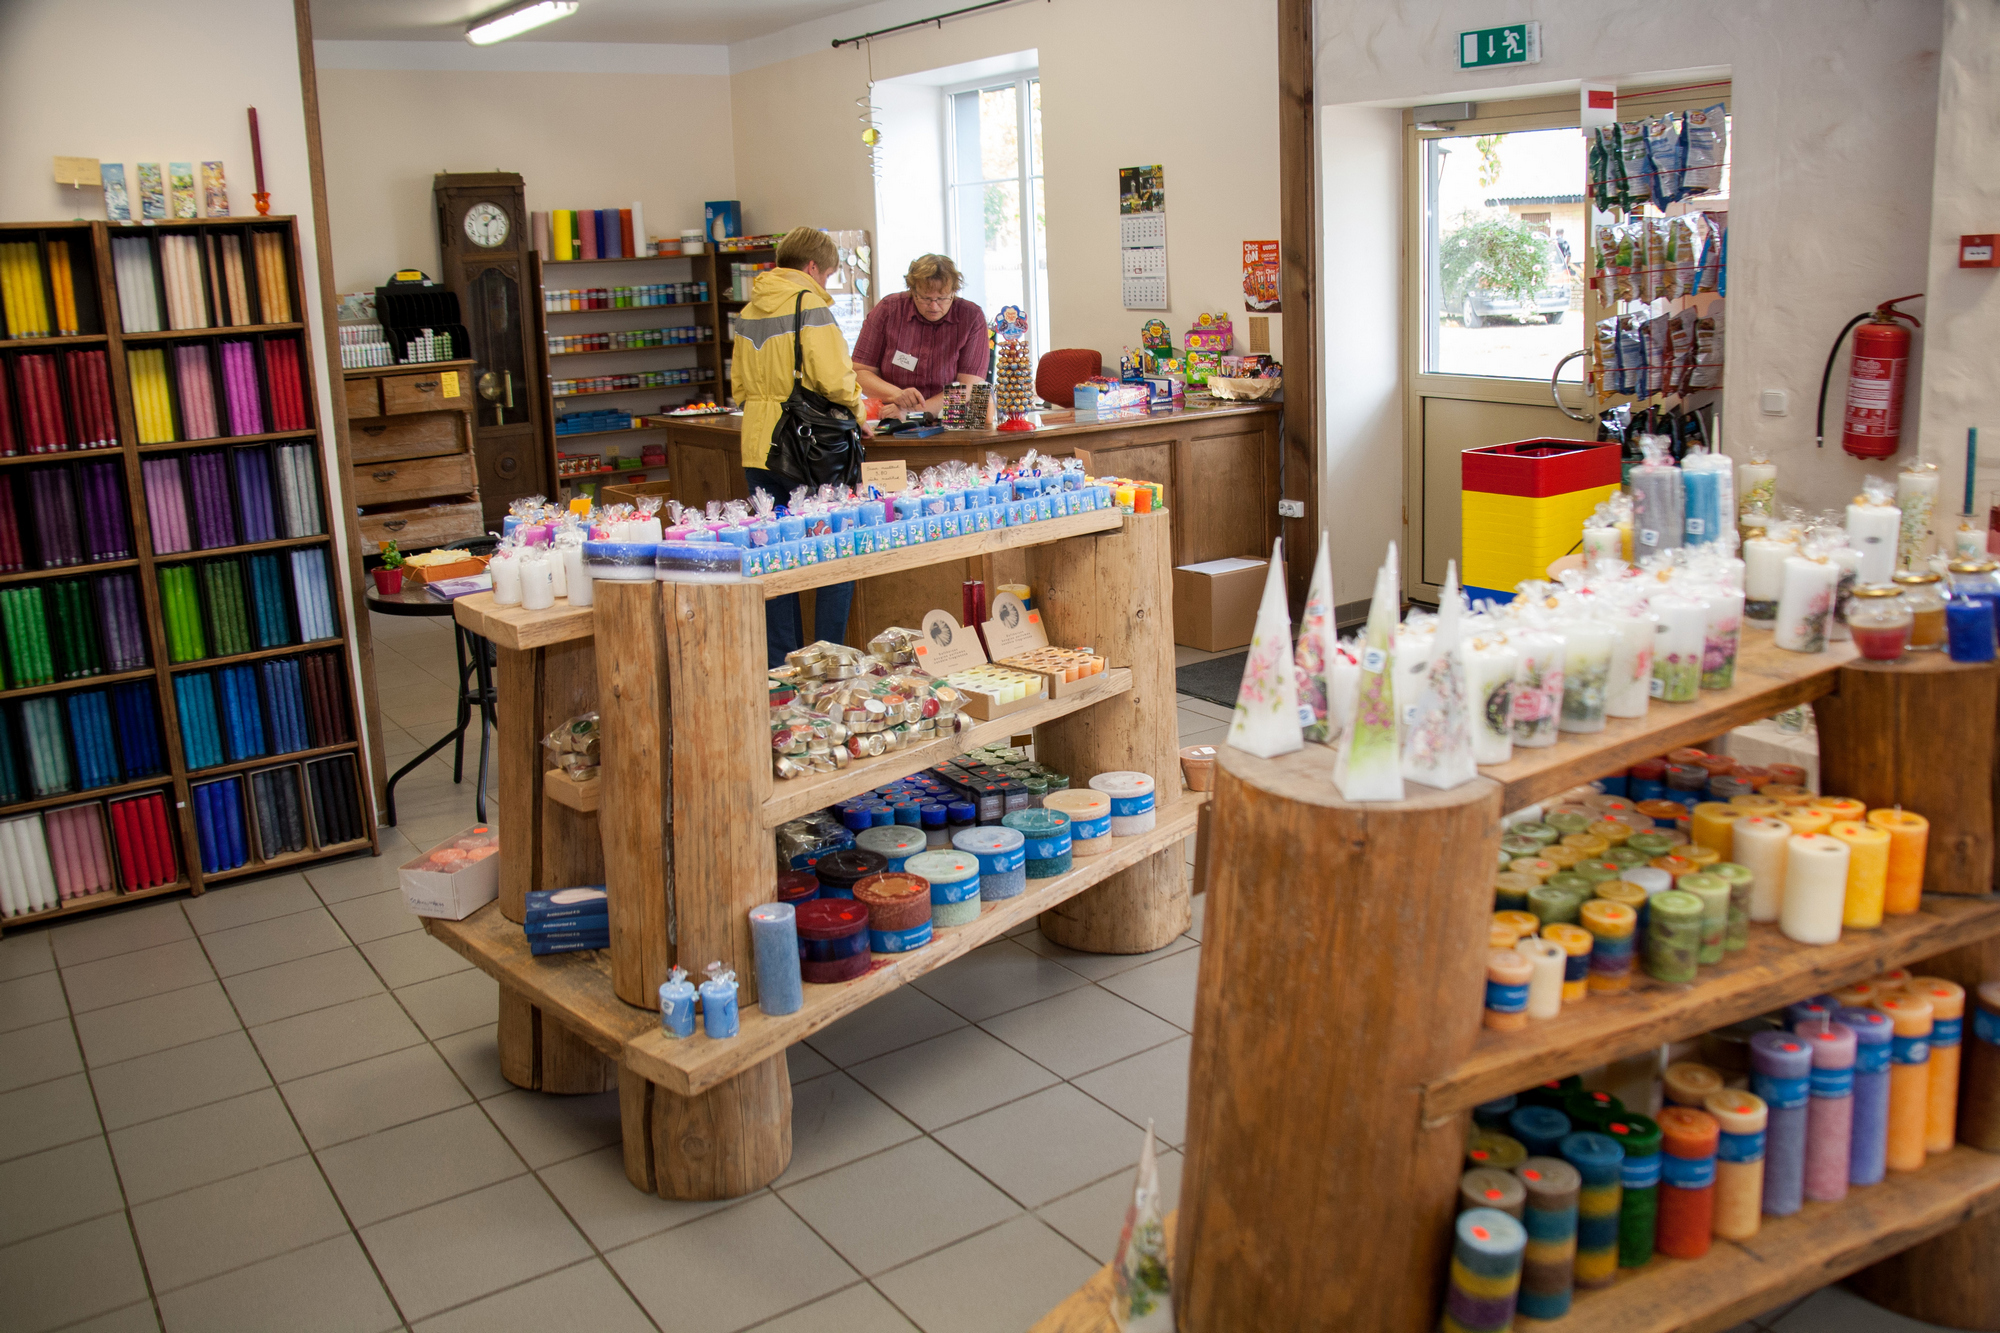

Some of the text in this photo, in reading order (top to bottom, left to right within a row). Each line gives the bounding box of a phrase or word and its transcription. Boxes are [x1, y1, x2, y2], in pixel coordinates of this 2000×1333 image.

[785, 551, 792, 562] 2
[801, 544, 810, 554] 2
[822, 540, 831, 553] 3
[839, 537, 847, 546] 3
[892, 527, 899, 537] 5
[911, 525, 917, 534] 5
[928, 520, 936, 532] 6
[945, 518, 952, 527] 6
[994, 508, 1000, 518] 8
[1010, 507, 1015, 517] 8
[1025, 504, 1032, 518] 9
[1040, 501, 1046, 511] 9
[682, 1000, 693, 1033] 4
